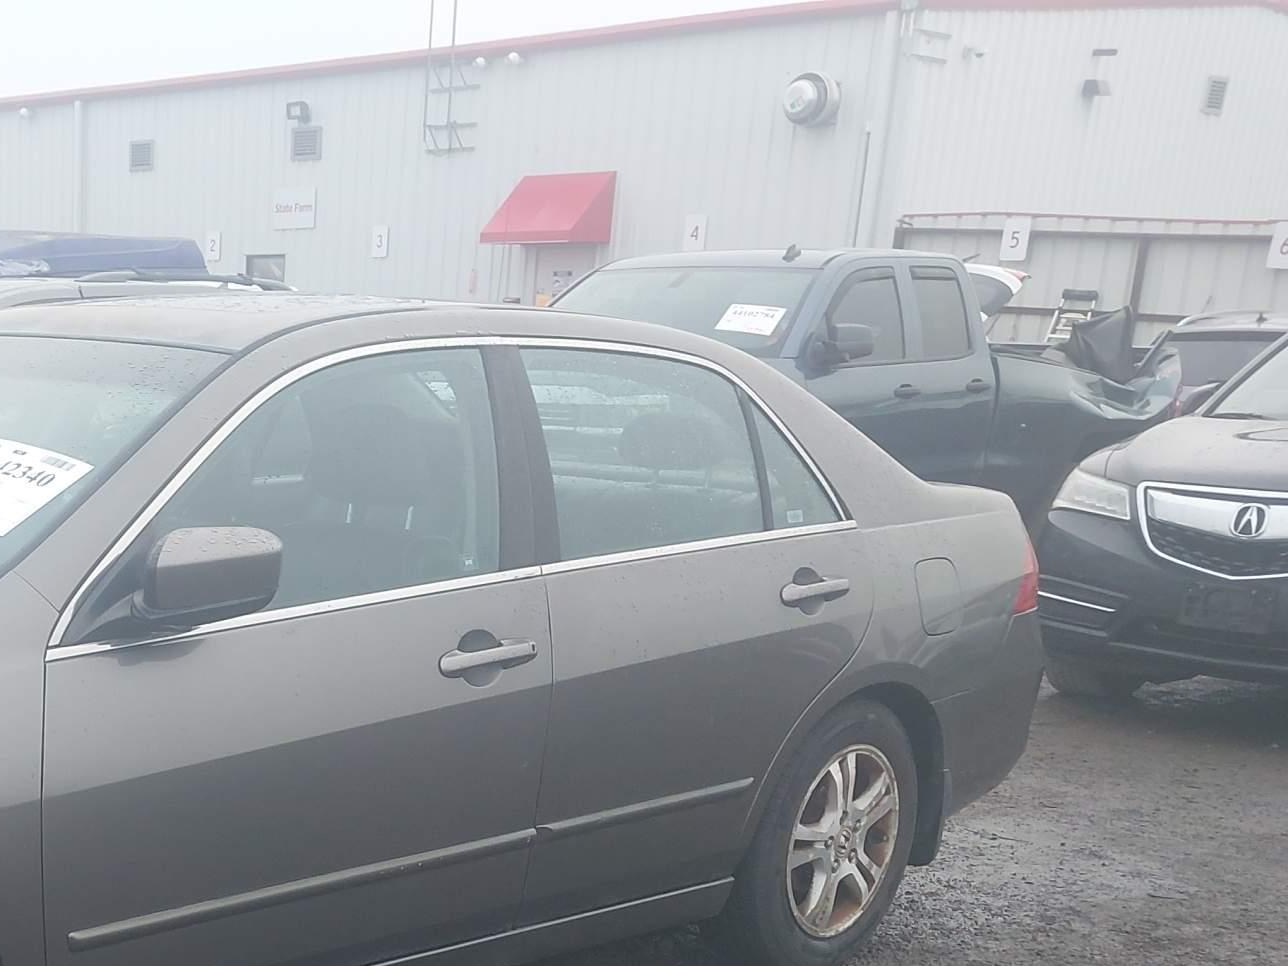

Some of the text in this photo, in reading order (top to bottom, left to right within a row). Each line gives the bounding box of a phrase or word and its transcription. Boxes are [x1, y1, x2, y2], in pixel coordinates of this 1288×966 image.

[376, 233, 383, 249] 3
[690, 225, 699, 241] 4
[1009, 231, 1020, 249] 5
[210, 239, 216, 252] 2
